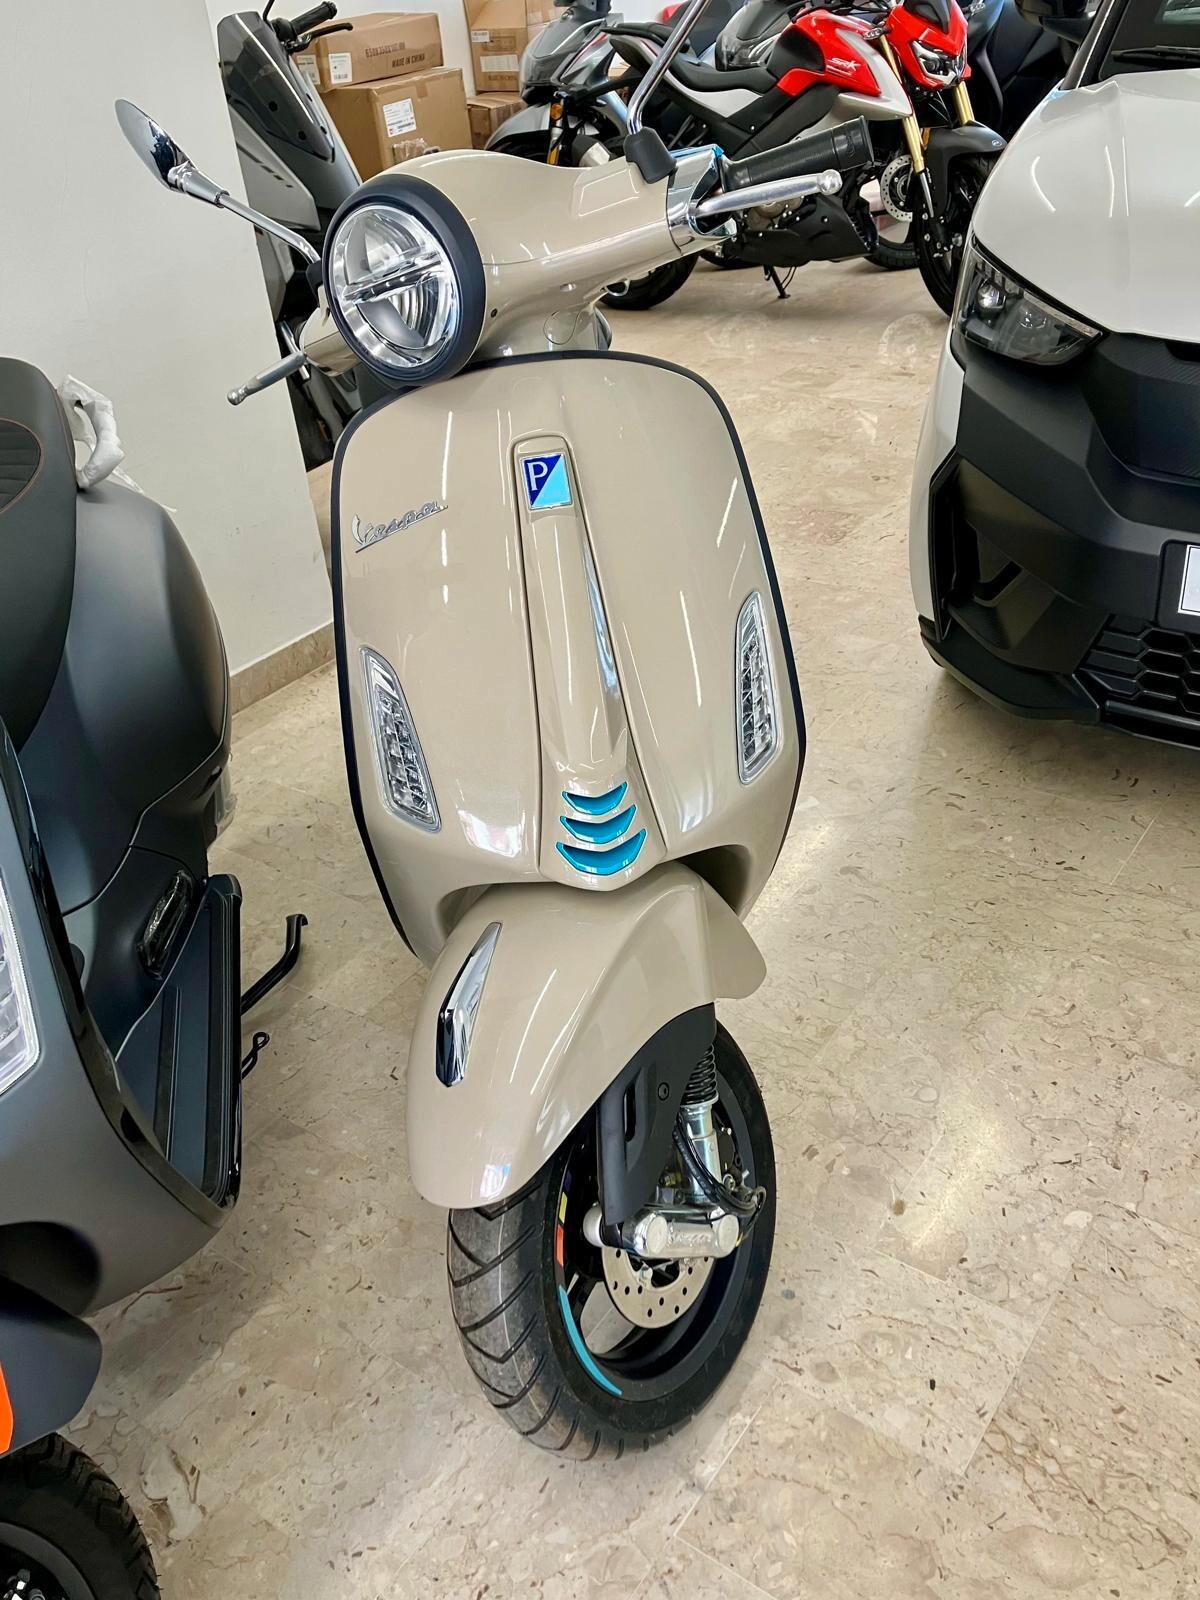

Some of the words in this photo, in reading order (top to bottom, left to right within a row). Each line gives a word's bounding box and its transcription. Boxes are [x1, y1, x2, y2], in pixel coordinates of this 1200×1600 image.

[392, 57, 405, 68] MADE
[405, 56, 411, 65] IN
[411, 53, 425, 64] CHINA
[828, 57, 861, 71] SRK
[526, 461, 548, 491] P
[351, 500, 448, 552] Vespa
